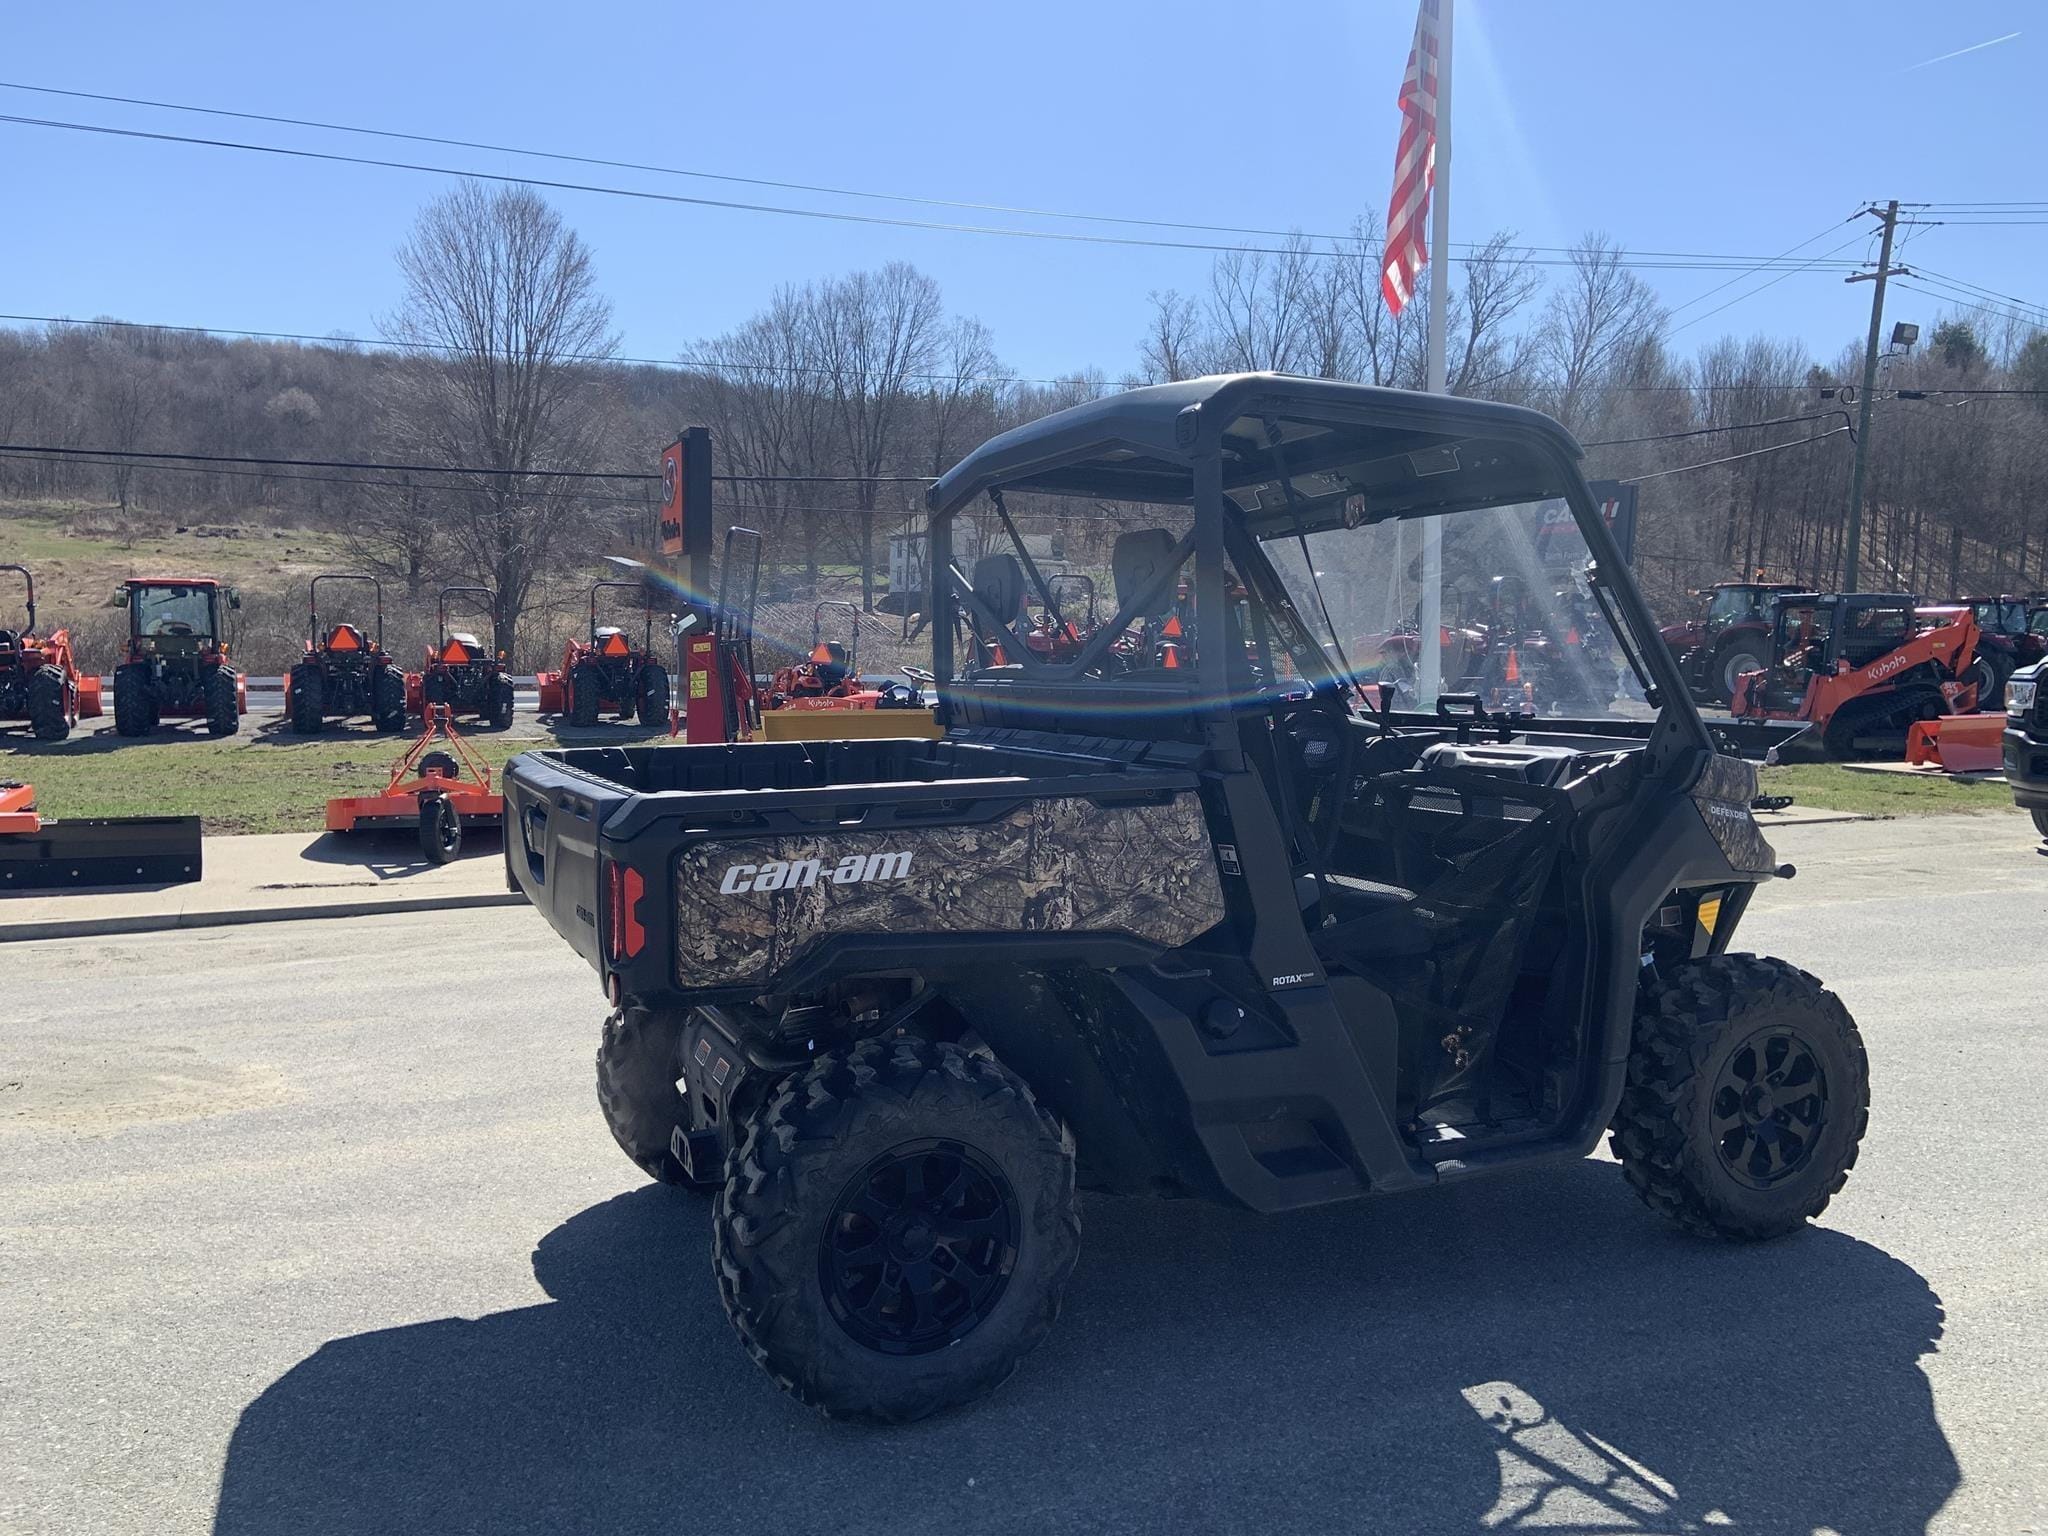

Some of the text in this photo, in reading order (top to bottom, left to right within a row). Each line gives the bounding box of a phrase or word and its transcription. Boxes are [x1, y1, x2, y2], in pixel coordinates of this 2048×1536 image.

[1867, 655, 1907, 679] Kubota
[808, 699, 834, 708] Kubota
[1711, 806, 1748, 820] DEFENDER
[719, 851, 913, 895] can-am
[1273, 974, 1302, 986] ROTAX
